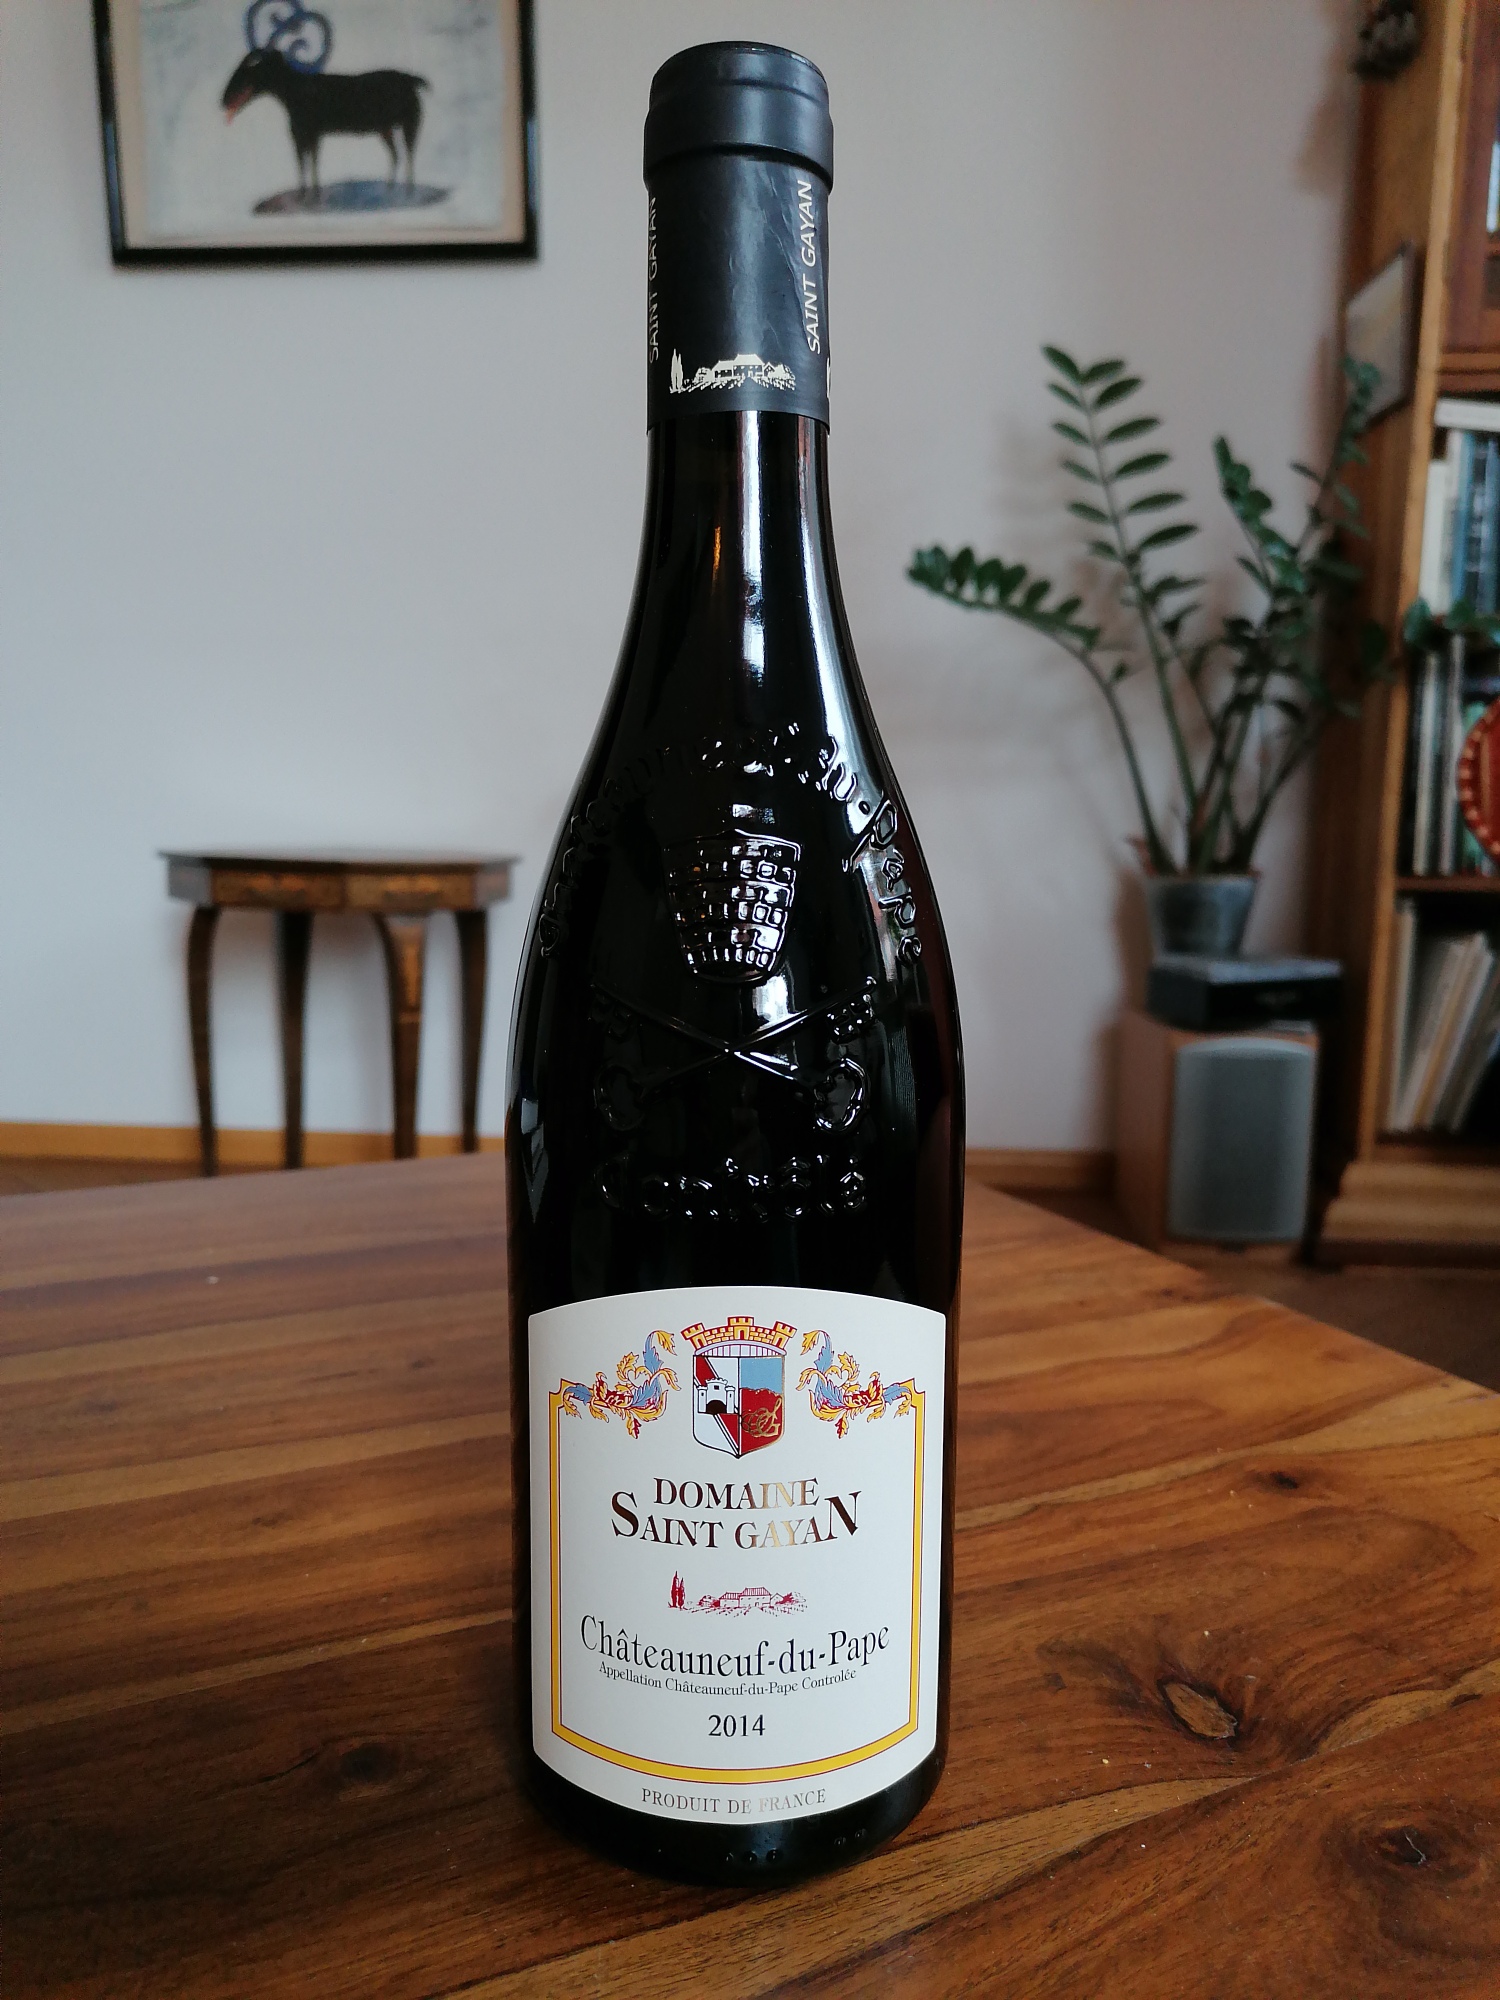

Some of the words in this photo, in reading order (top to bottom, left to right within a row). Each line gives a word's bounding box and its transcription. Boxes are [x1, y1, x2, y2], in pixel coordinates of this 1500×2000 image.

[797, 180, 817, 267] GAYAN
[803, 274, 820, 355] SAINT
[652, 1476, 820, 1510] DOMAINE
[610, 1490, 724, 1549] SAINT
[734, 1490, 862, 1550] GAYAN
[579, 1614, 890, 1677] Châteauneuf-du-Pape
[598, 1661, 662, 1689] Appellation
[665, 1678, 799, 1696] Châteauneuf-du-Pape
[707, 1714, 766, 1737] 2014
[641, 1787, 721, 1813] PRODUIT
[727, 1799, 752, 1815] DE
[758, 1788, 827, 1813] FRANCE
